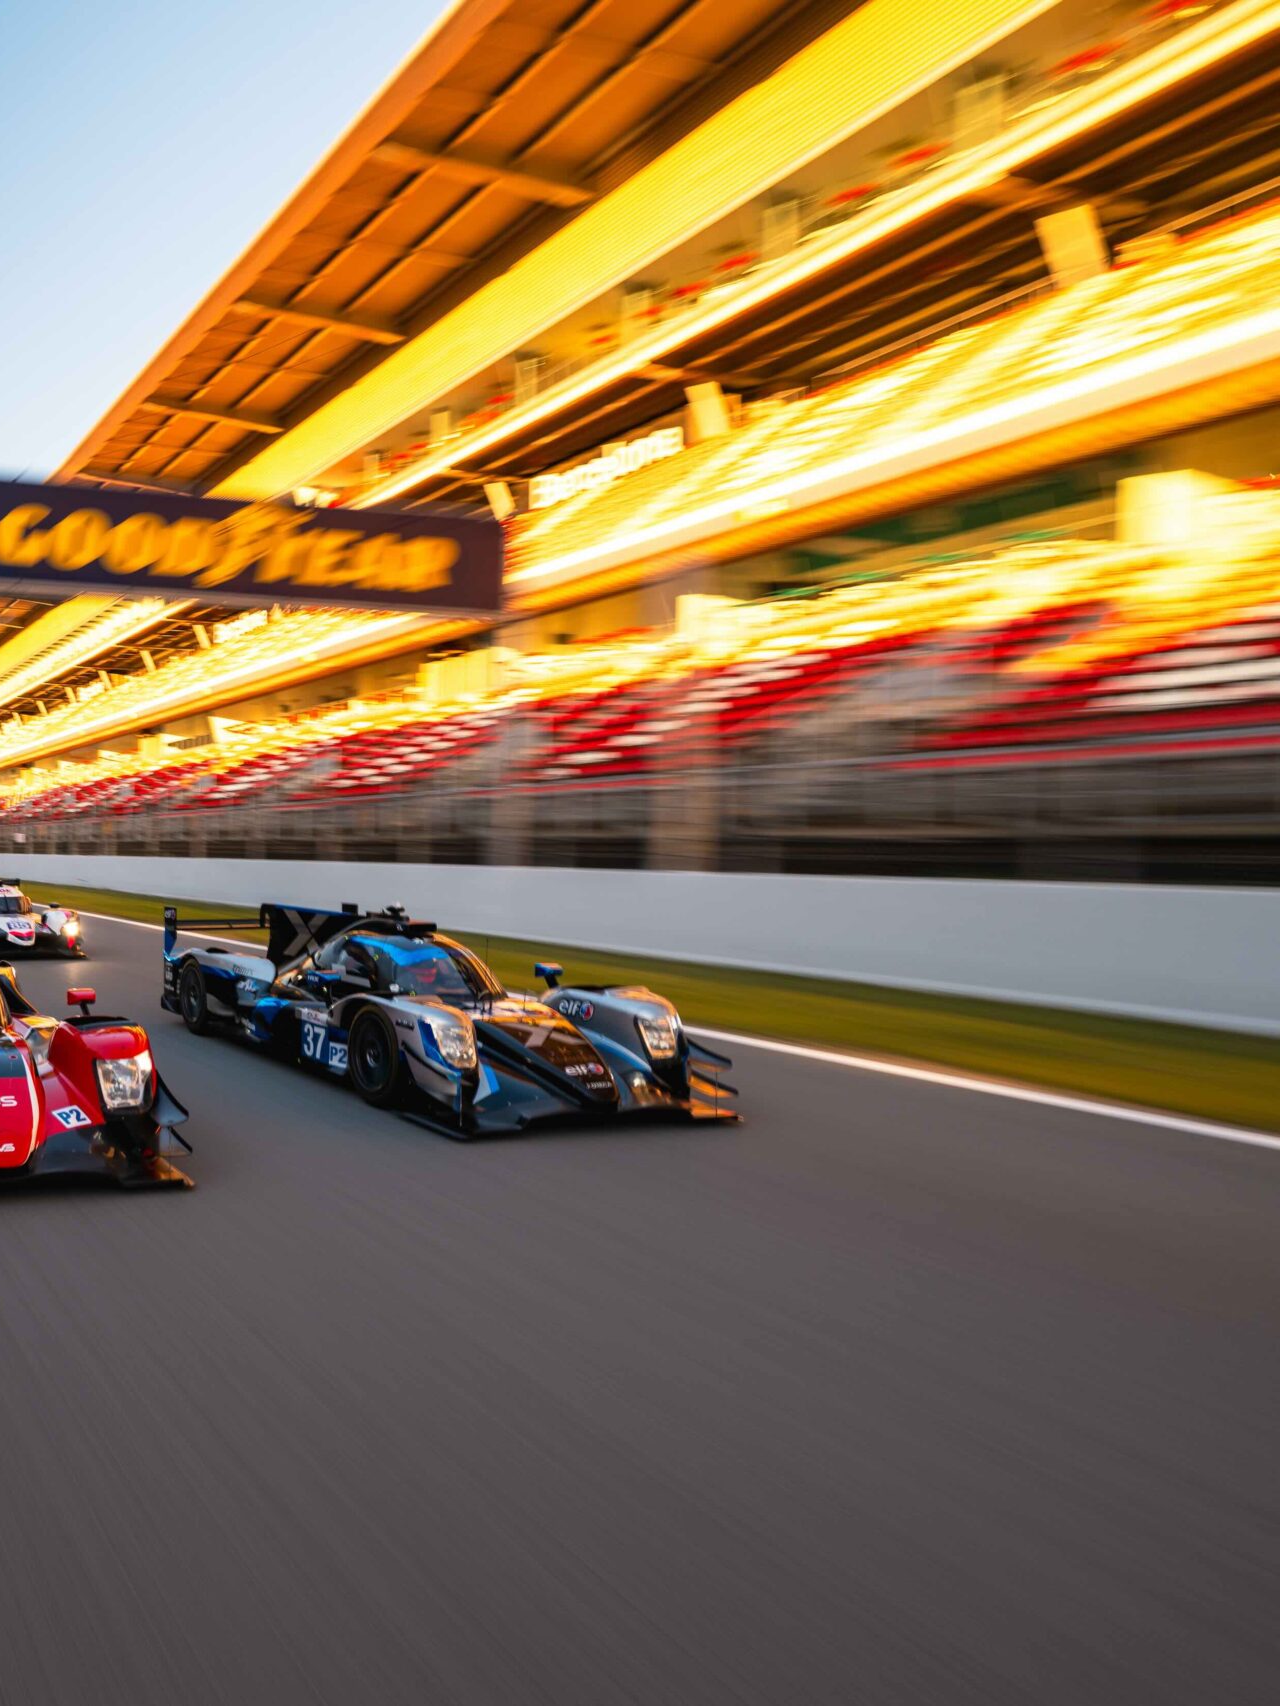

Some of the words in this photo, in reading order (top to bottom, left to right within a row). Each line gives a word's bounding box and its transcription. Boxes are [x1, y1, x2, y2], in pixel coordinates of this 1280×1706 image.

[559, 999, 581, 1016] elf
[303, 1023, 326, 1060] 37
[330, 1045, 347, 1064] P2
[565, 1064, 588, 1076] elf
[57, 1108, 87, 1125] P2
